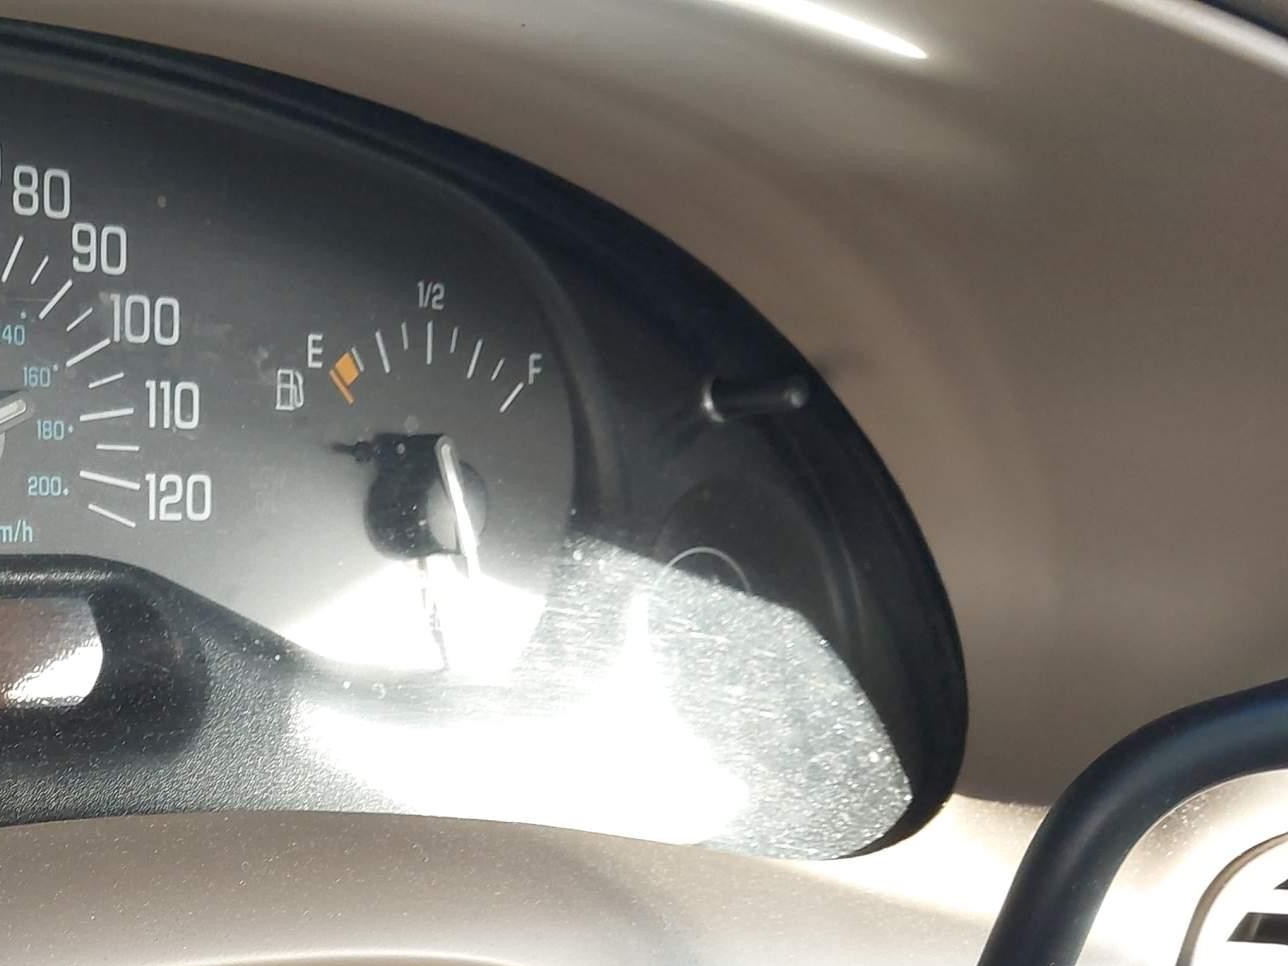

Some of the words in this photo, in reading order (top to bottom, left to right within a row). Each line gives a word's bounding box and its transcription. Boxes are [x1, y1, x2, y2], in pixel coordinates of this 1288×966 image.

[13, 166, 70, 218] 80
[72, 223, 126, 274] 90
[418, 282, 444, 310] 1/2
[110, 293, 180, 346] 100
[308, 334, 322, 367] E
[24, 367, 50, 387] 160
[529, 354, 541, 384] F
[146, 381, 199, 429] 110
[37, 420, 64, 440] 180
[28, 476, 61, 496] 200
[146, 474, 211, 520] 120
